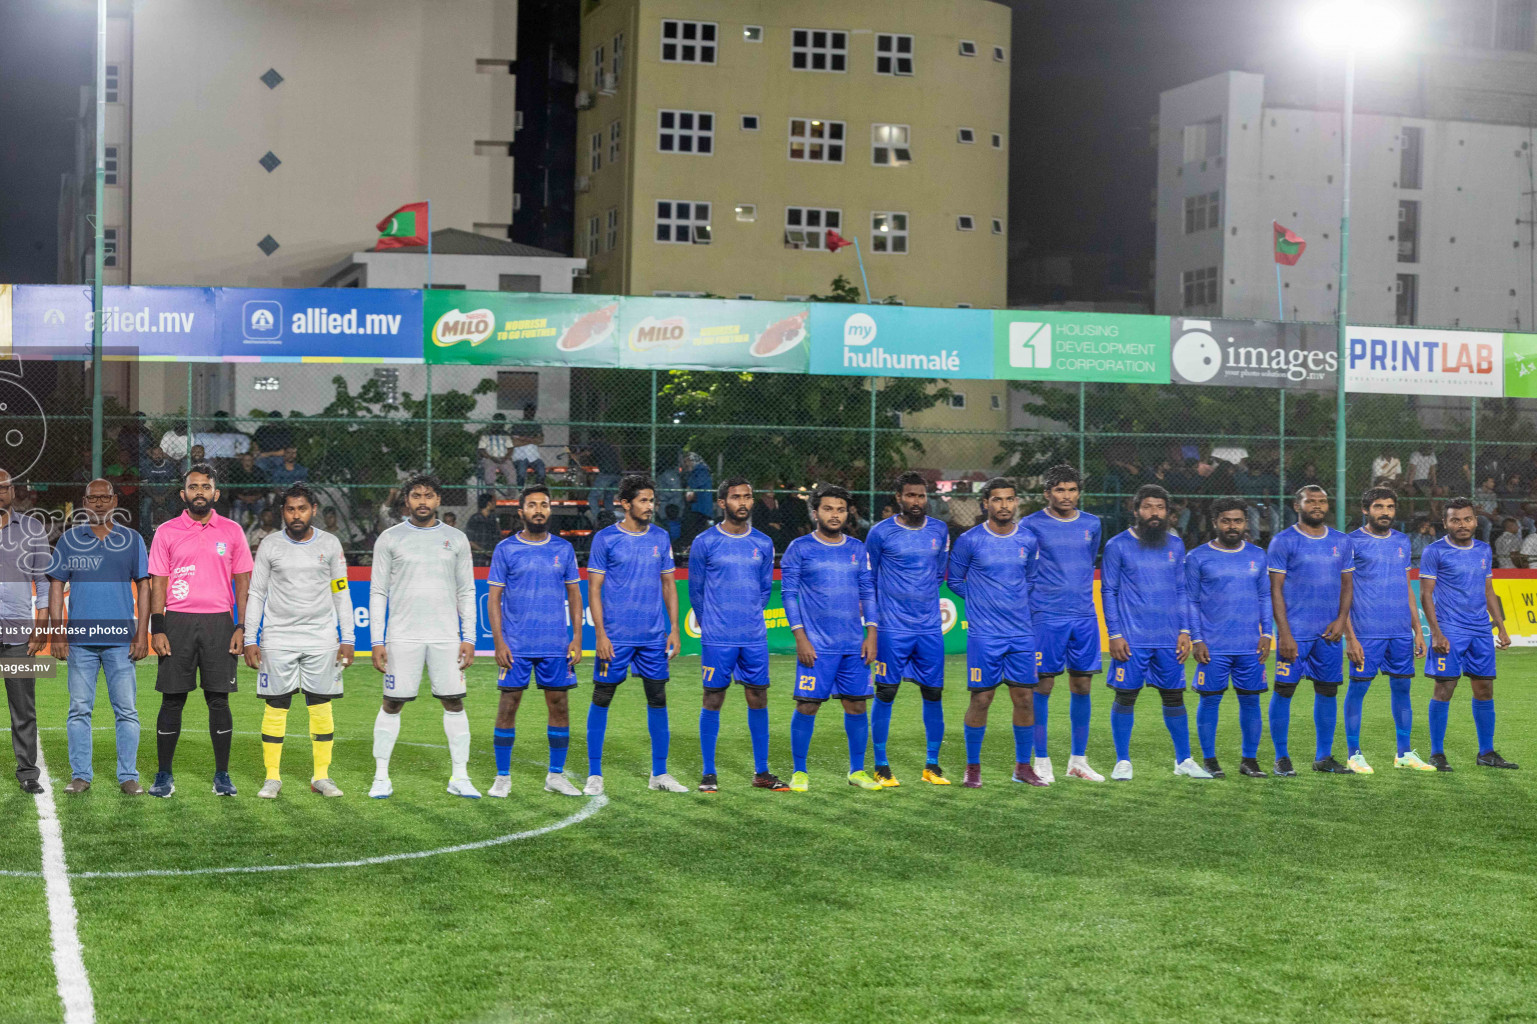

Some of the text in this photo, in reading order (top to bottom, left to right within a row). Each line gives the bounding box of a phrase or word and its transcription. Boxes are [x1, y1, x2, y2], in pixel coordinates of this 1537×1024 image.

[292, 308, 402, 334] allied.mv
[505, 318, 547, 330] NOURISH
[442, 320, 489, 337] MILO
[497, 328, 556, 340] TO GO FURTHER
[637, 326, 684, 342] MILO
[848, 325, 872, 339] my
[1056, 324, 1118, 336] HOUSING
[1056, 340, 1156, 355] DEVELOPMENT
[844, 346, 960, 371] hulhumalé
[1056, 358, 1156, 372] CORPORATION
[1226, 337, 1338, 380] images
[1240, 369, 1260, 378] photo
[336, 580, 346, 590] C
[1276, 661, 1290, 676] 25
[1438, 658, 1446, 672] 5
[702, 666, 715, 682] 77
[970, 668, 982, 682] 10
[1198, 672, 1205, 686] 8
[799, 676, 816, 691] 23
